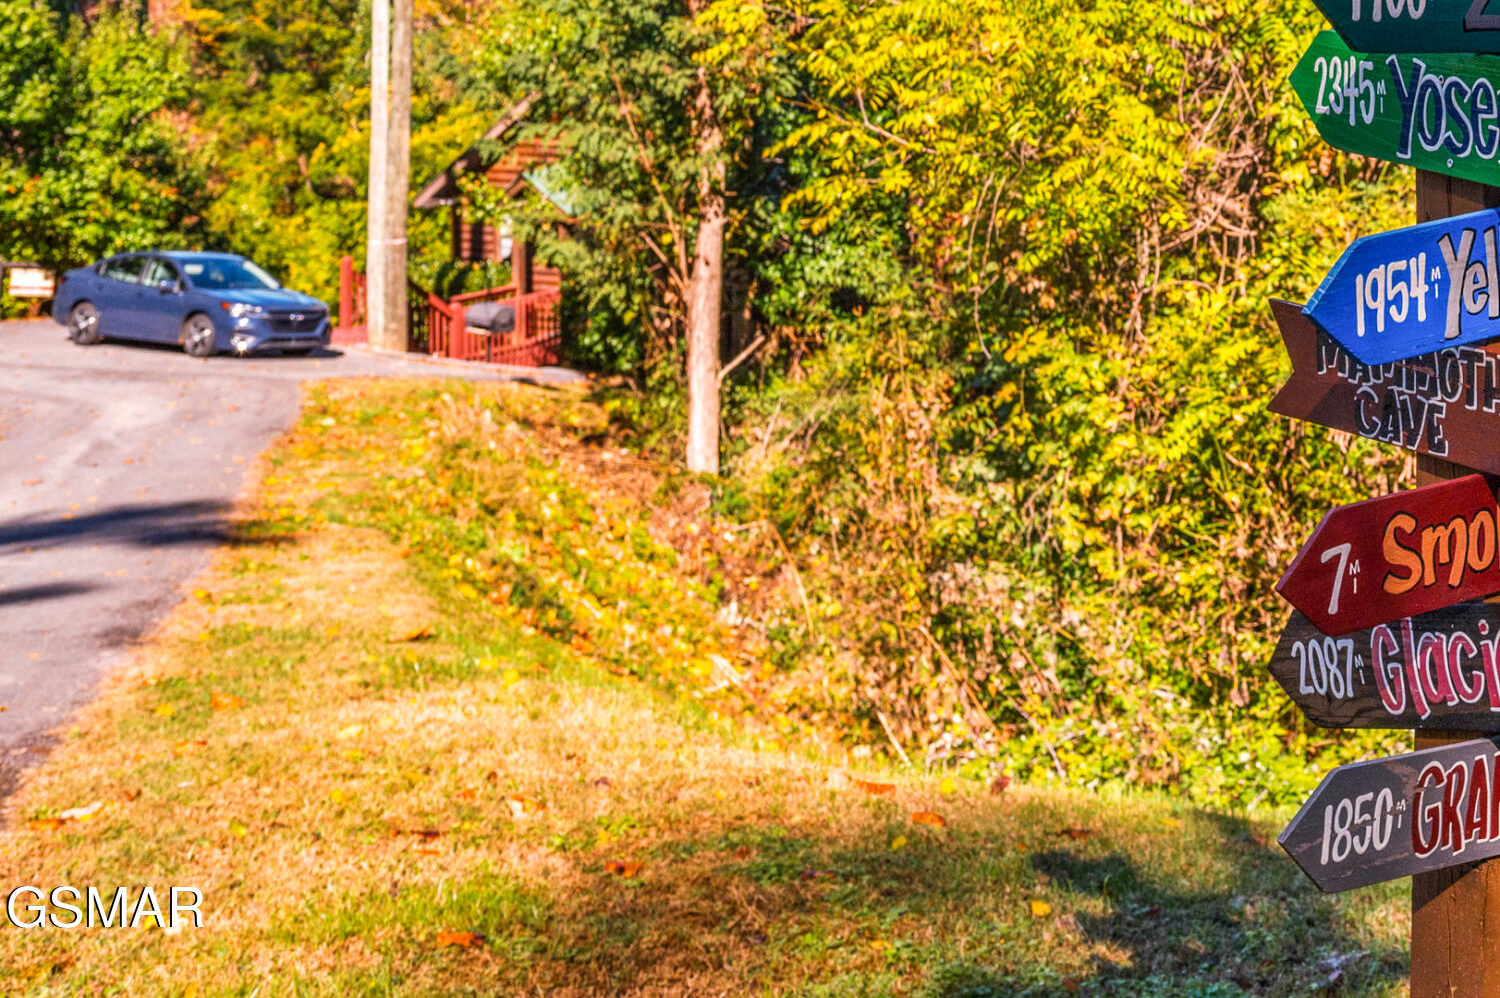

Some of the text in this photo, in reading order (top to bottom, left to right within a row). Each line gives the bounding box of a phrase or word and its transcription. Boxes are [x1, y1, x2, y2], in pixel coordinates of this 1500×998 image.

[1313, 55, 1376, 127] 2345
[1355, 251, 1429, 338] 1954
[1354, 384, 1449, 457] CAVE
[1320, 542, 1352, 616] 7
[1290, 635, 1355, 700] 2087
[1320, 786, 1394, 866] 1850
